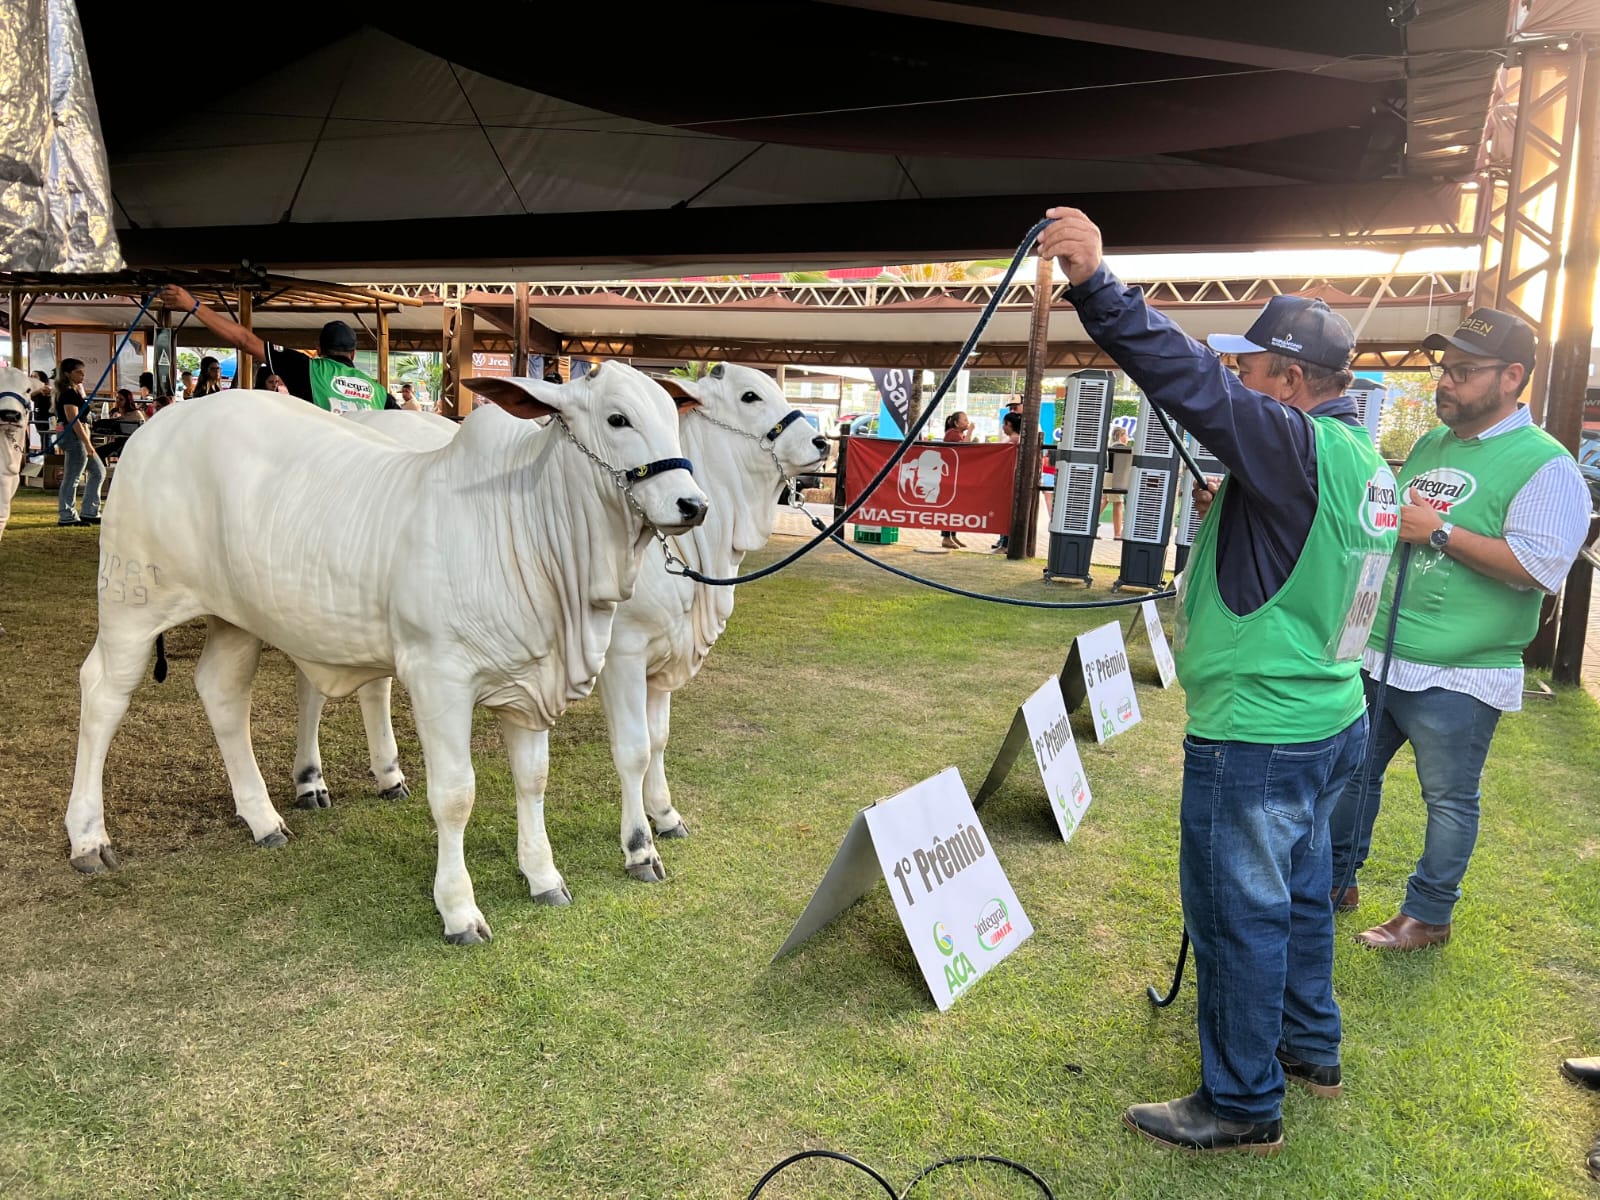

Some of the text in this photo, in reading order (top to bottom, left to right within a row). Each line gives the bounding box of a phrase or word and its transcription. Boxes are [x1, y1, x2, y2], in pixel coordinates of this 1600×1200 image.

[1409, 475, 1467, 498] integral
[859, 508, 988, 529] MASTERBOI
[1096, 650, 1126, 683] Prêmio
[1043, 713, 1071, 761] Prêmio
[913, 823, 986, 893] Prêmio
[974, 904, 1007, 937] integral
[943, 951, 977, 994] ACA
